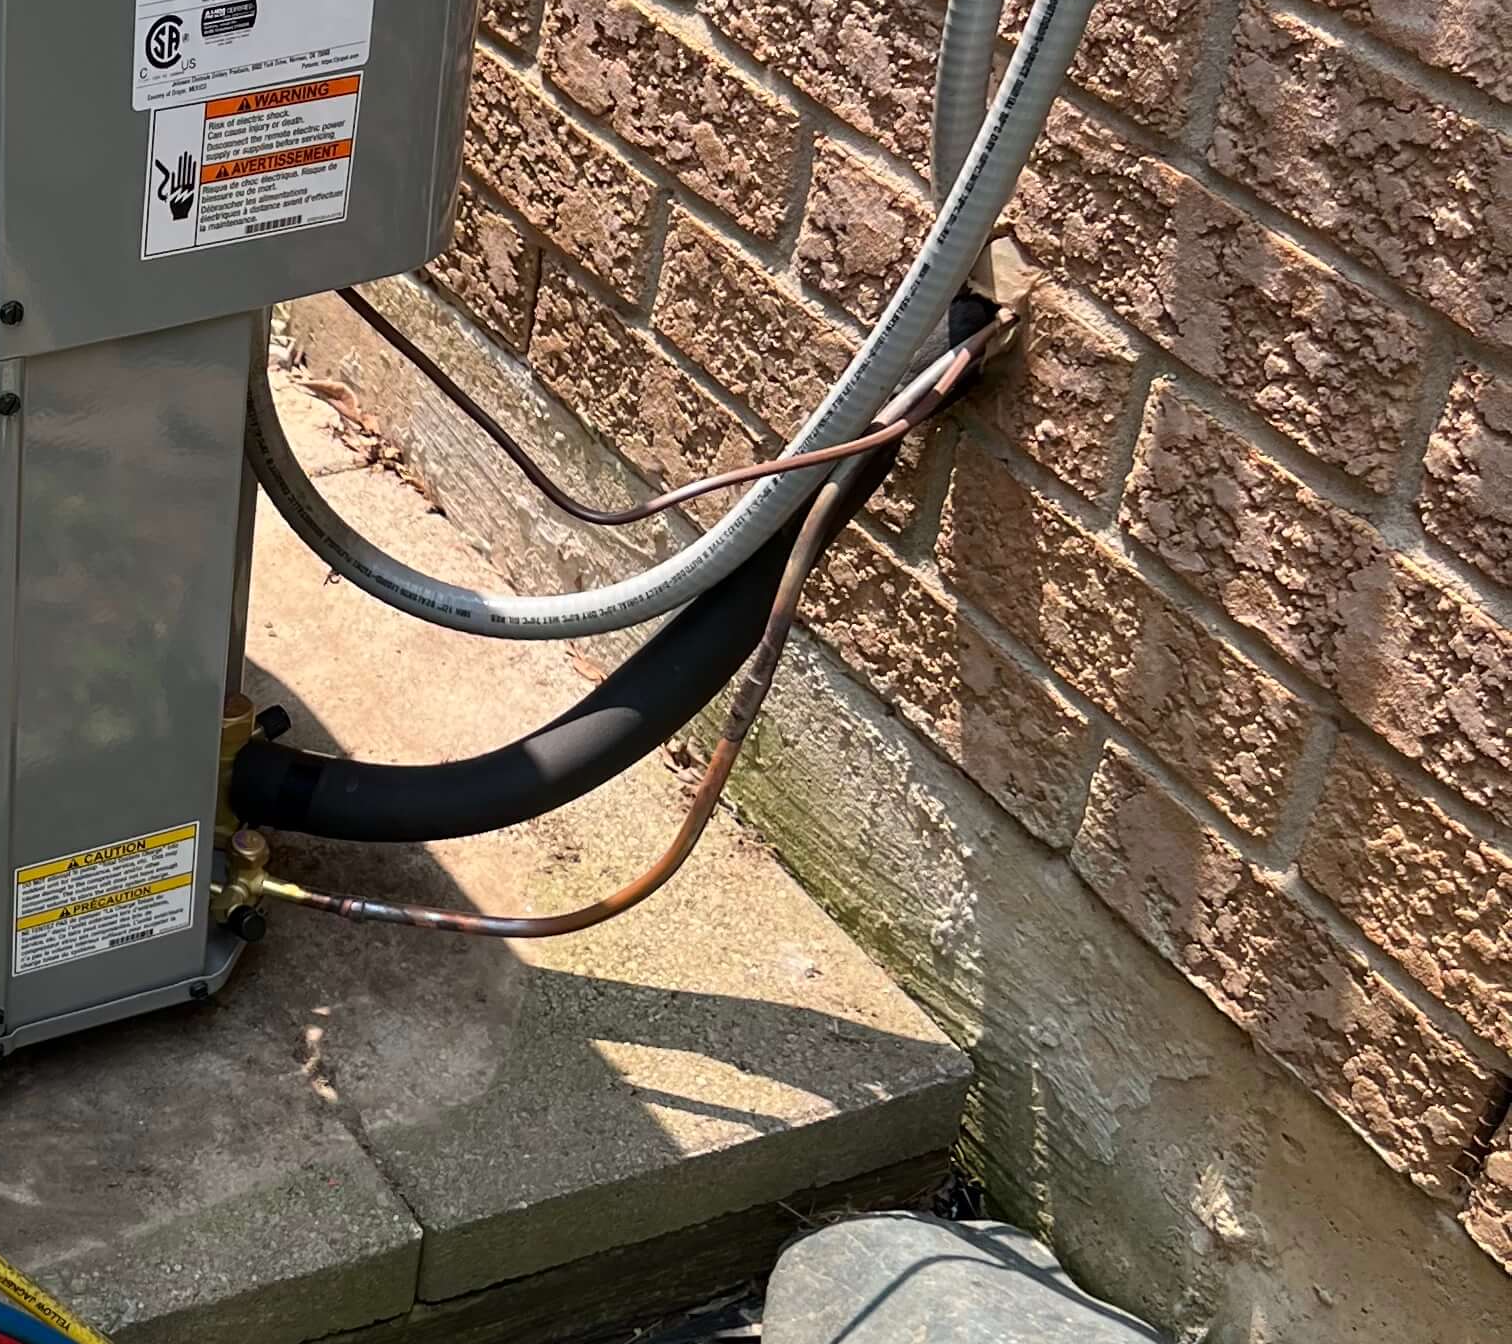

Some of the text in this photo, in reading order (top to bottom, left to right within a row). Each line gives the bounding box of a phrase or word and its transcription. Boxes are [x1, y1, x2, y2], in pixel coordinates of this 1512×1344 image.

[254, 83, 330, 107] WARNING
[207, 131, 223, 140] Can
[224, 128, 246, 138] cause
[248, 122, 270, 135] injury
[208, 112, 264, 130] Risk of electric
[206, 119, 346, 152] Disconnect the remote electric power
[206, 136, 300, 162] supply or supplies before
[231, 143, 339, 176] AVERTISSEMENT
[202, 162, 338, 195] Risque de choc Risque de
[200, 187, 308, 214] Débrancher les alimentations
[200, 189, 344, 224] électriques à distance avant d'effectuer
[201, 183, 277, 204] blessure ou de mort.
[199, 215, 258, 232] la maintenance.
[83, 839, 147, 865] CAUTION
[72, 885, 153, 913] PRÉCAUTION
[36, 1297, 71, 1331] YELLOW
